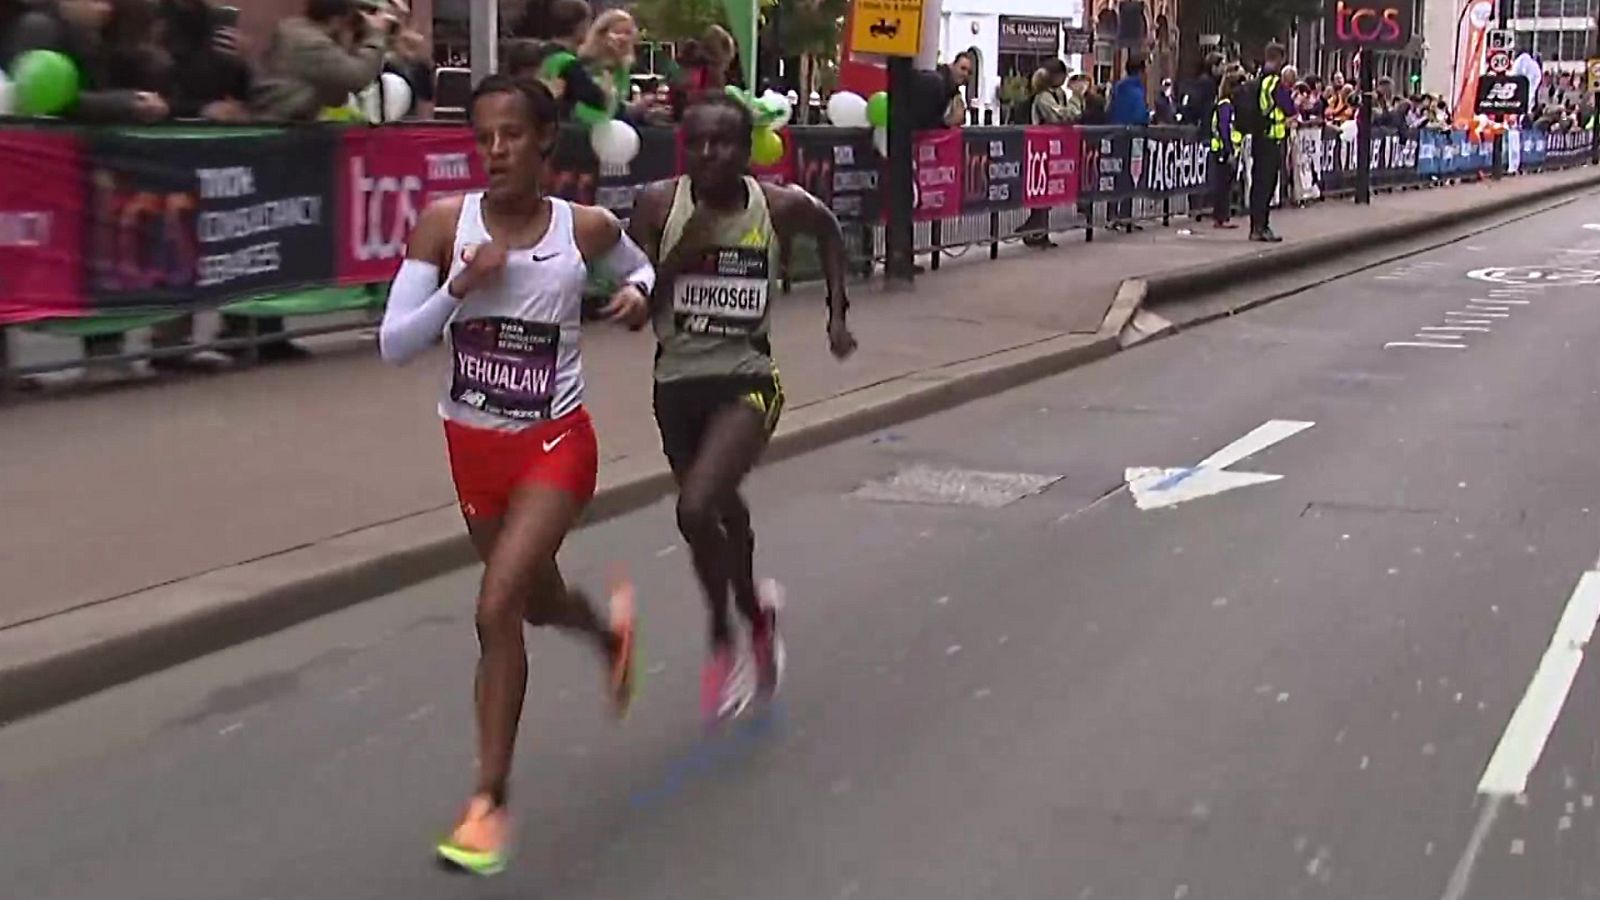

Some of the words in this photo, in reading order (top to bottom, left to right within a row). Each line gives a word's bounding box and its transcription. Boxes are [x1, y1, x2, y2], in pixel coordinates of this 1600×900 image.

[1003, 23, 1016, 35] THE
[1017, 23, 1058, 36] RAJASTHAN
[1336, 0, 1400, 40] tcs
[1026, 139, 1047, 197] tcs
[681, 283, 760, 311] JEPKOSGEI
[458, 351, 550, 396] YEHUALAW
